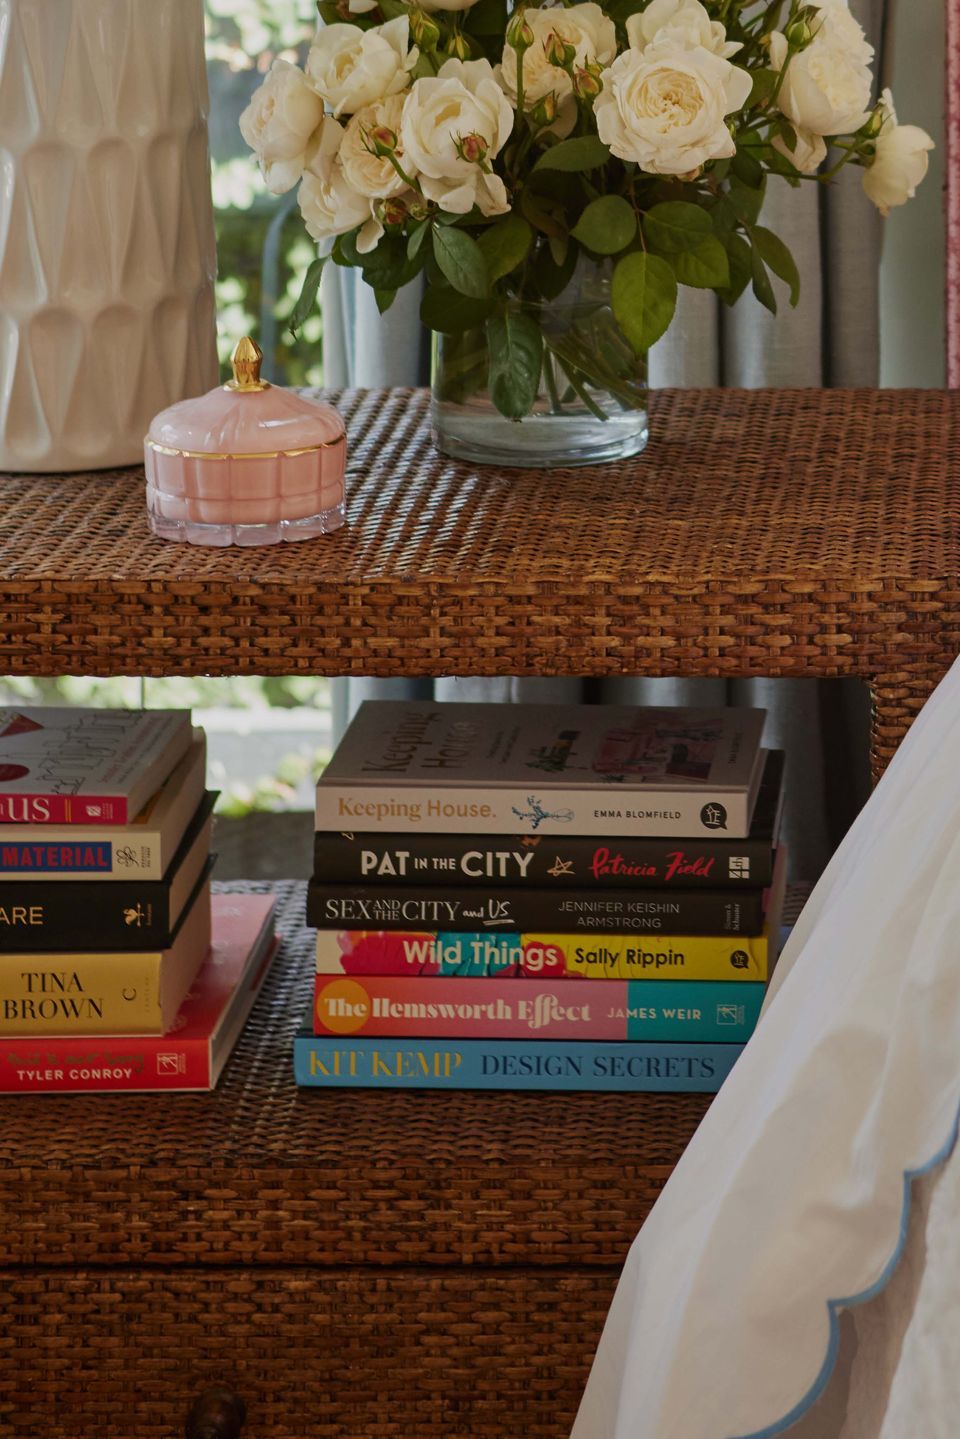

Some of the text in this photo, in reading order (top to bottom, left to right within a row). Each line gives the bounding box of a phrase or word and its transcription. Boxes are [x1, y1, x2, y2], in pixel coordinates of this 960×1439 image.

[338, 797, 496, 821] Keeping House.
[593, 810, 681, 820] EMMA BLOMFIELD
[1, 846, 109, 868] MATERIAL
[360, 850, 535, 877] PAT IN THE CITY
[587, 847, 716, 881] Patricia Field
[325, 899, 511, 921] SEX AND THE CITY and US
[558, 900, 680, 914] JENNIFER KEISHIN
[577, 916, 662, 929] ARMSTRONG
[403, 940, 558, 971] Wild Things
[575, 947, 685, 969] Sally Rippin
[21, 972, 86, 993] TINA
[3, 998, 104, 1020] BROWN
[324, 994, 592, 1030] The Hemsworth Effect
[607, 1007, 702, 1021] JAMES WEIR
[16, 1067, 133, 1082] TYLER CONROY
[309, 1050, 462, 1078] KIT KEMP
[482, 1054, 715, 1079] DESIGN SECRETS
